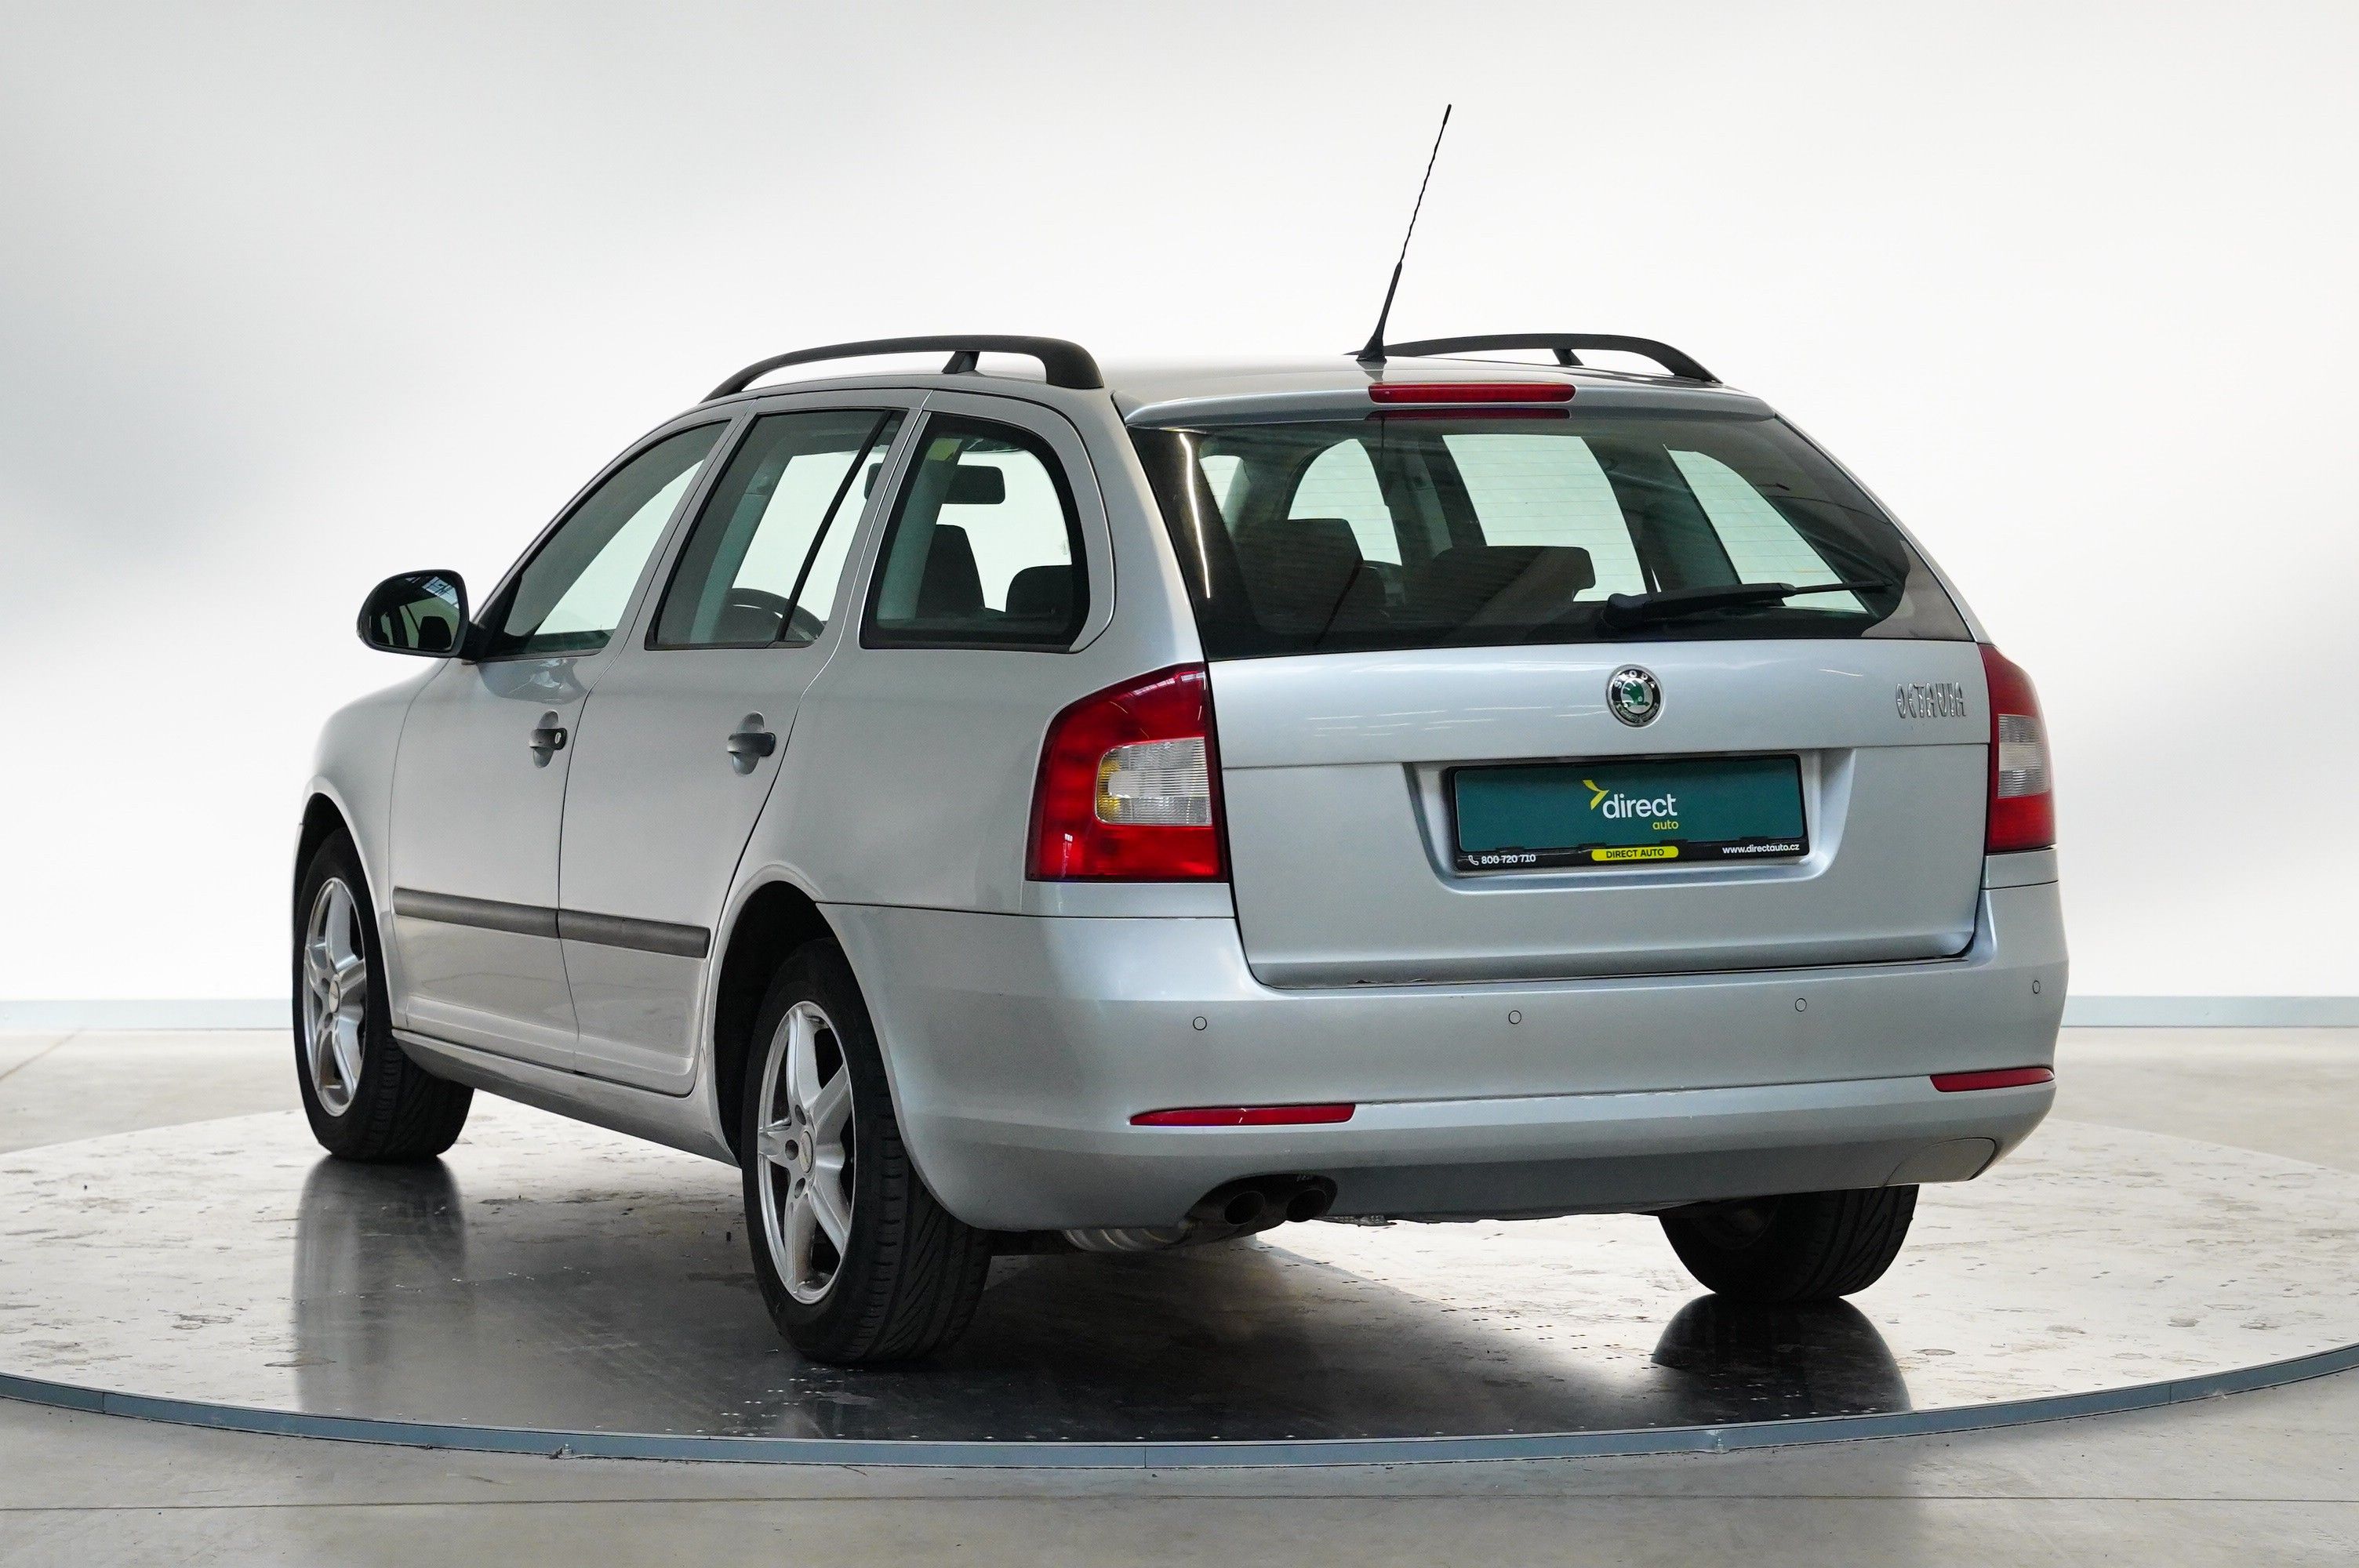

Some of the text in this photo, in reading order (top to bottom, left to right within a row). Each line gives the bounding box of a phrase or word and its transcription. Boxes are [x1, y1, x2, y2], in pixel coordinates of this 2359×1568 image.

[1896, 682, 1966, 718] OCTAVIA
[1602, 793, 1678, 819] direct
[1652, 819, 1679, 830] auto
[1605, 848, 1665, 858] DIRECT AUTO
[1722, 844, 1800, 854] www.directauto.cz
[1481, 854, 1536, 864] 800 720 710
